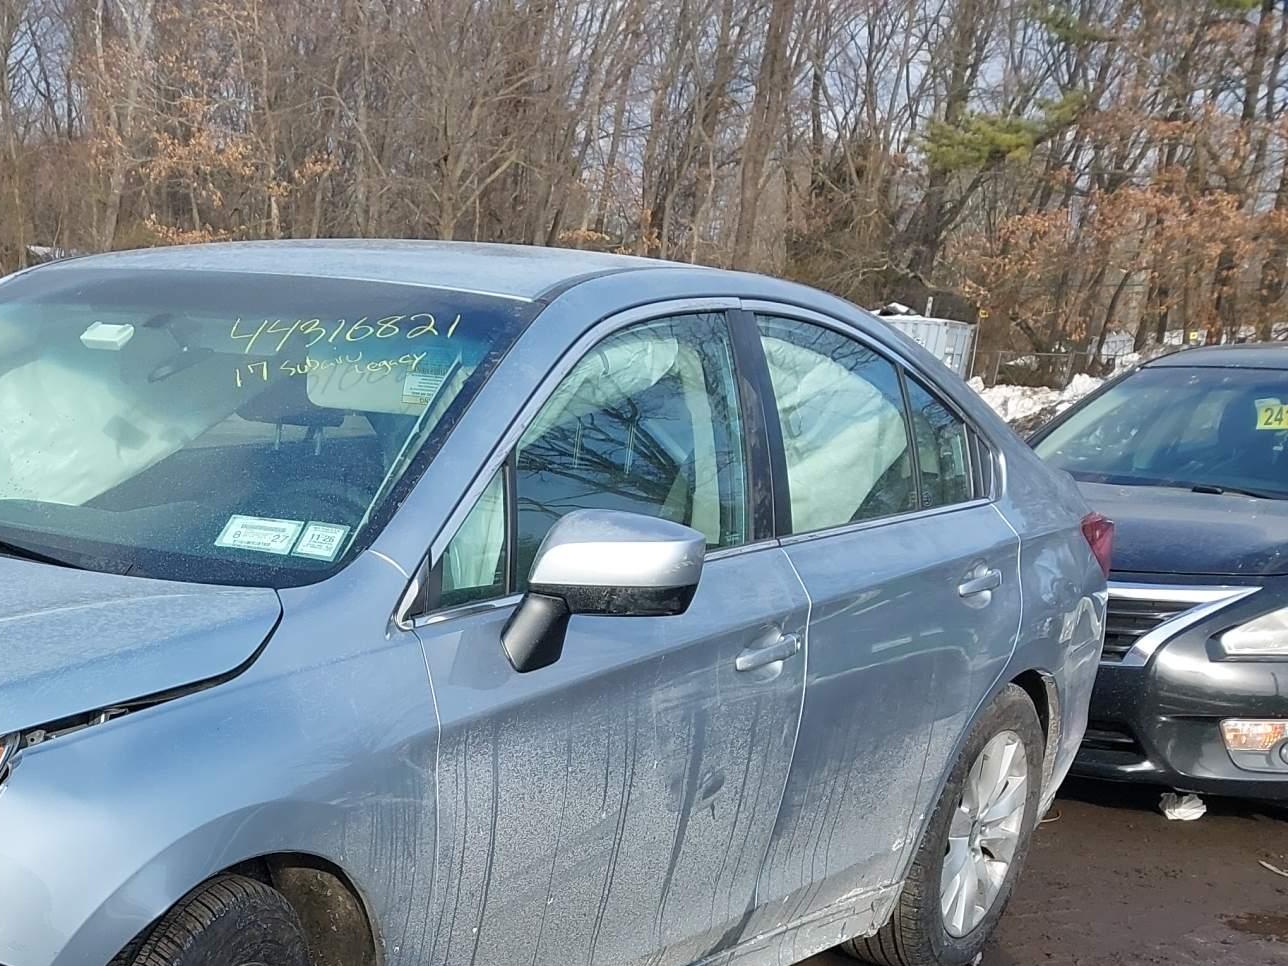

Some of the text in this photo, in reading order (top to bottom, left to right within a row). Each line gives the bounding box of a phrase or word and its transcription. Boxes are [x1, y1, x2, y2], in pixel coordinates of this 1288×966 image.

[230, 313, 461, 354] 44316821
[234, 360, 268, 388] 17
[1263, 407, 1288, 426] 24
